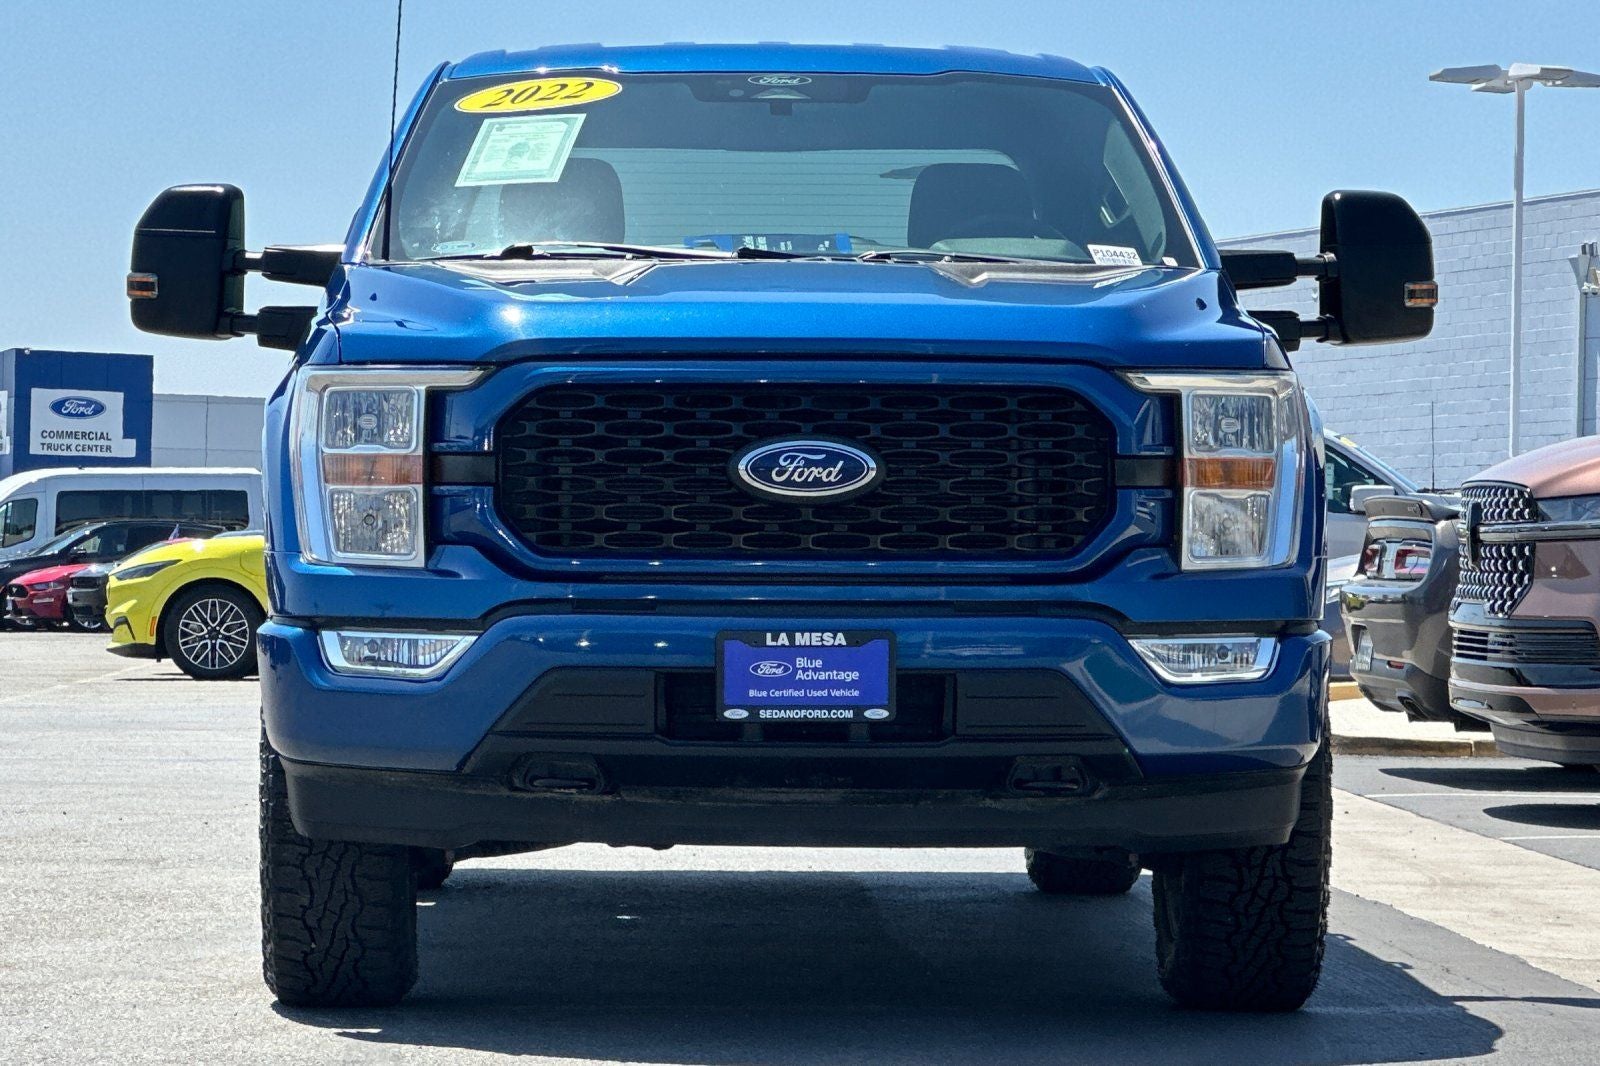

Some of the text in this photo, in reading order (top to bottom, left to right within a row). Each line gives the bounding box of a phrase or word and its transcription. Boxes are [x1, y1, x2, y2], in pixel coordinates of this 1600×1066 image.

[759, 76, 801, 84] Ford
[480, 81, 595, 109] 2022
[1092, 248, 1138, 260] P104432
[61, 399, 95, 416] Ford
[40, 430, 112, 441] COMMERCIAL
[40, 442, 112, 453] TRUCK CENTER
[771, 452, 845, 482] Ford
[765, 632, 847, 646] LA MESA
[757, 662, 785, 675] Ford
[795, 657, 823, 668] Blue
[795, 669, 860, 682] Advantage
[748, 688, 860, 697] Blue Certified Used Vehicle
[758, 709, 854, 719] SEDANOFORD.COM
